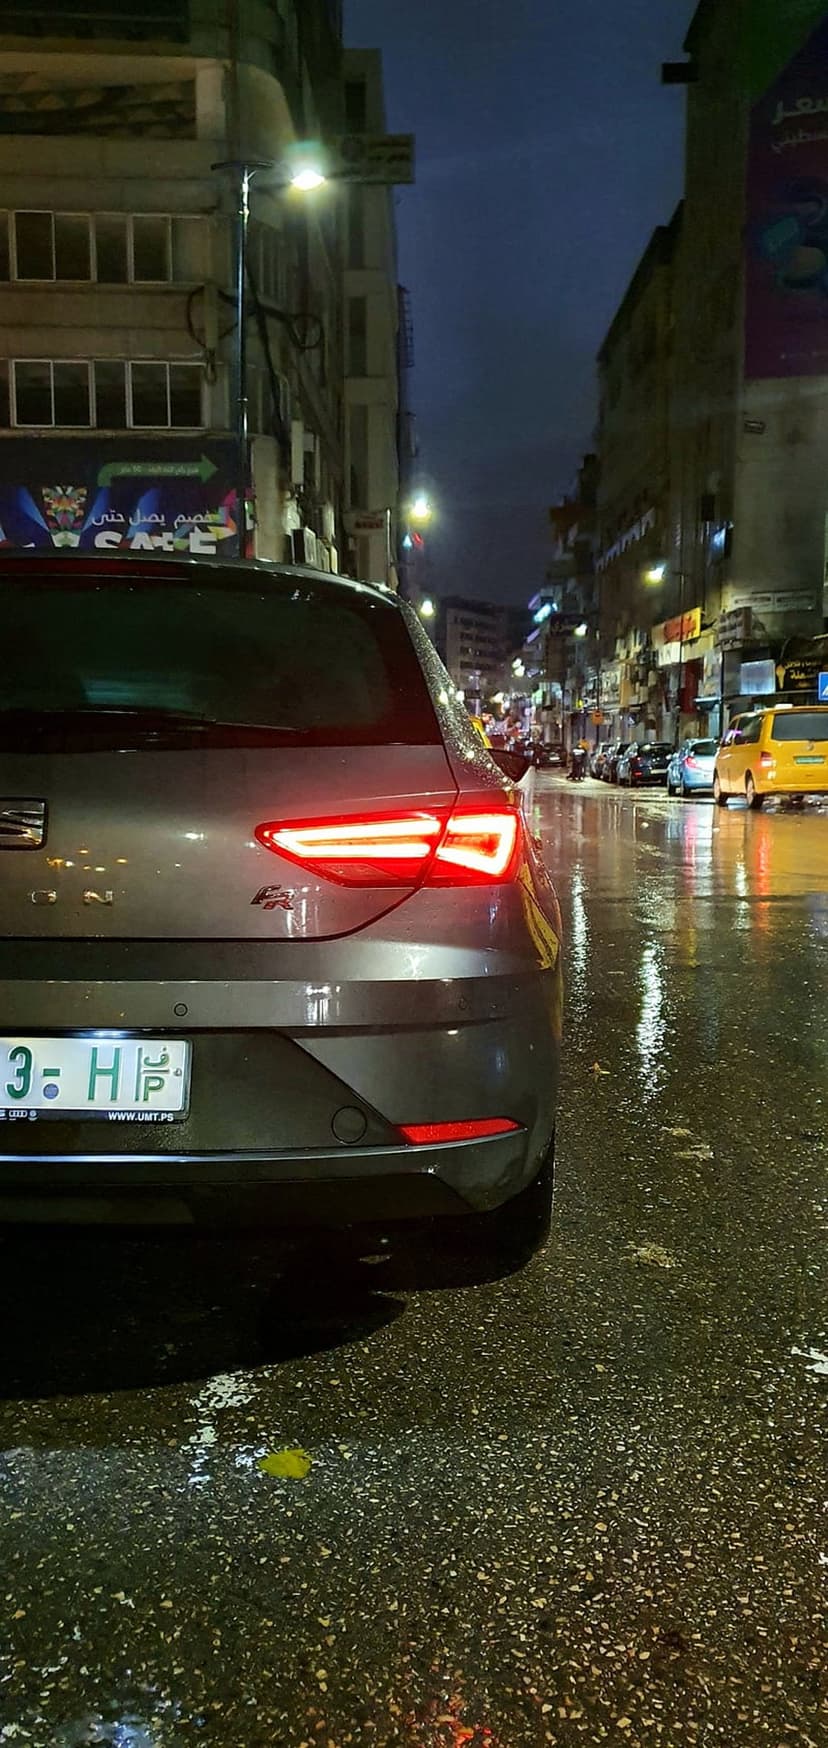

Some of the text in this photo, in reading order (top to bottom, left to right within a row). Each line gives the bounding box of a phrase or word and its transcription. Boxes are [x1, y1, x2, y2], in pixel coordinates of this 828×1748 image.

[129, 508, 166, 526] يصل
[174, 511, 214, 529] خصم
[108, 1112, 174, 1122] WWW.UMT.PS
